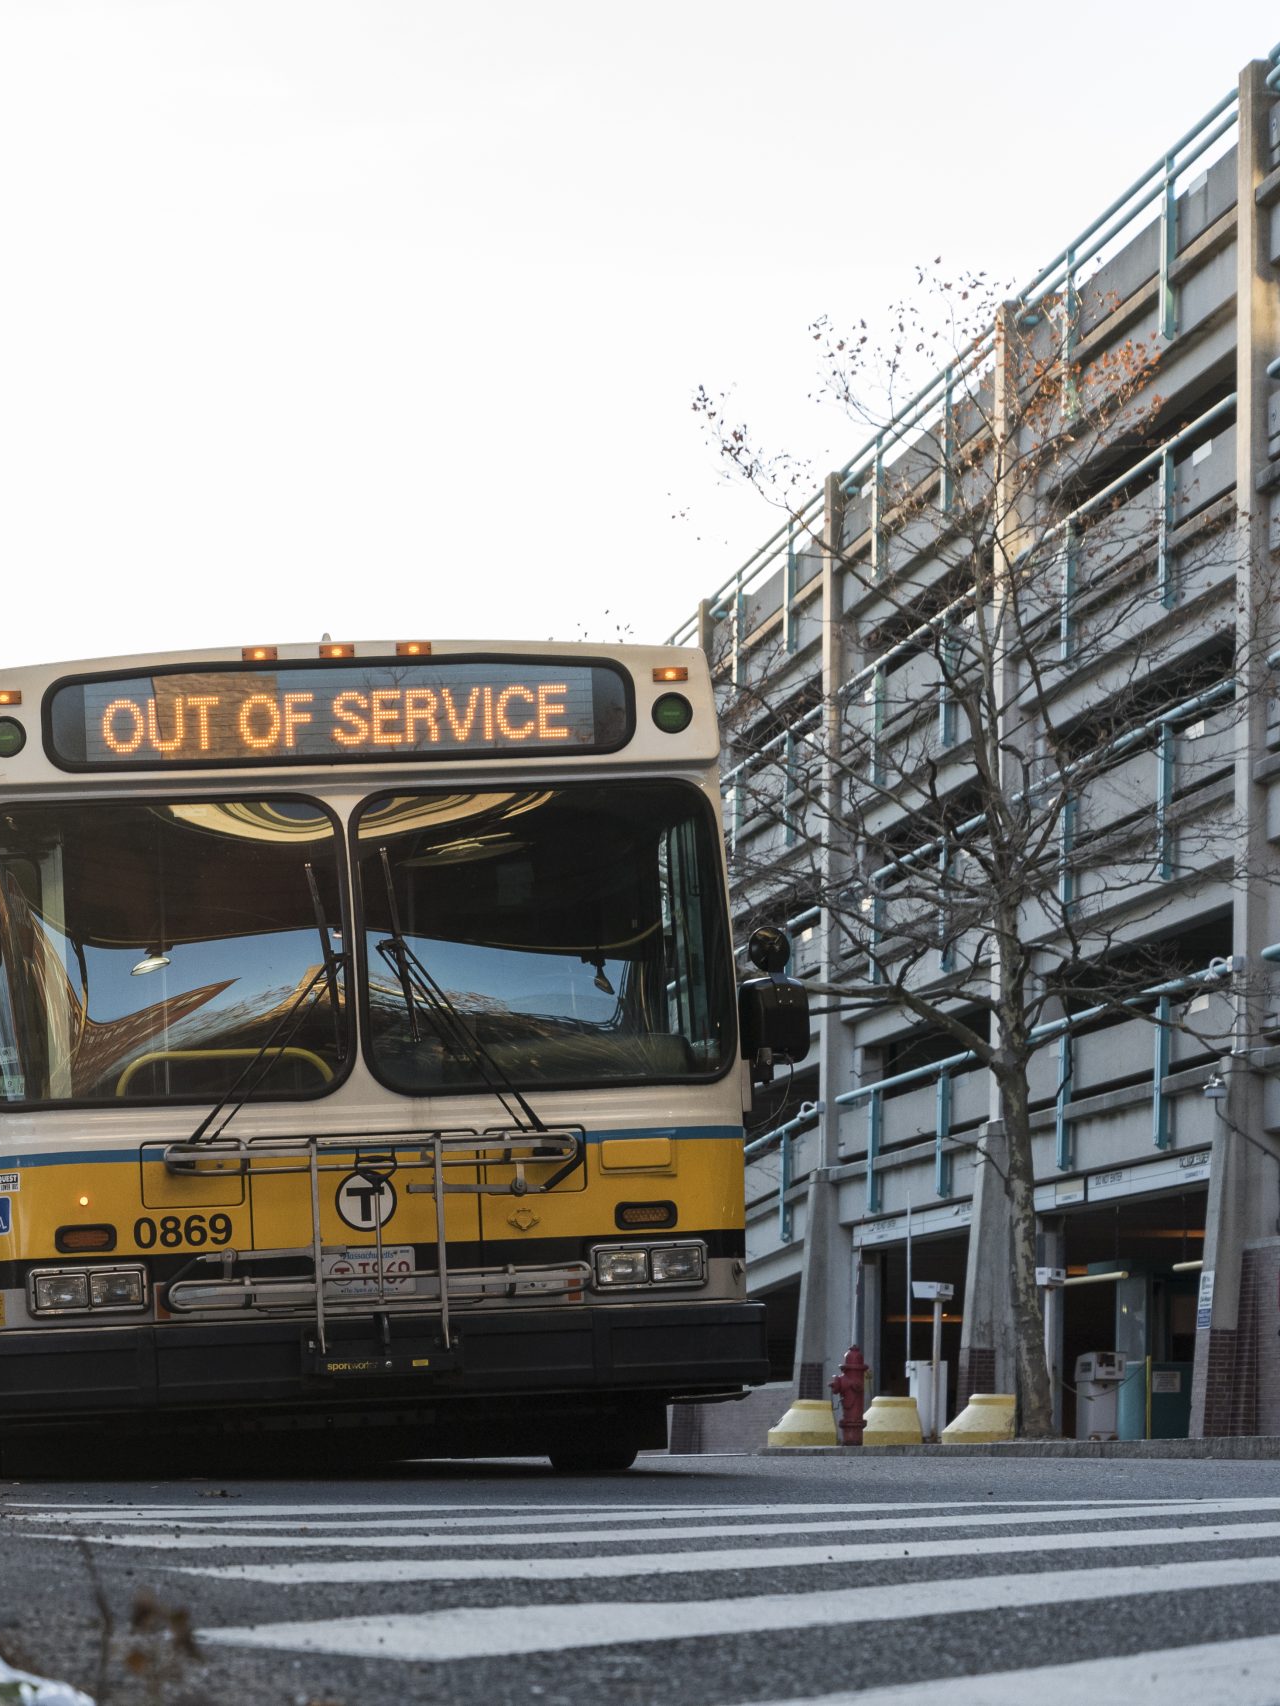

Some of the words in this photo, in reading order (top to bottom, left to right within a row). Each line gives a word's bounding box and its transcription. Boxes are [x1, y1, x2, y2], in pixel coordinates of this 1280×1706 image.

[102, 696, 220, 753] OUT
[239, 693, 314, 748] OF
[332, 684, 568, 745] SERVICE
[347, 1187, 384, 1221] T
[133, 1213, 232, 1249] 0869
